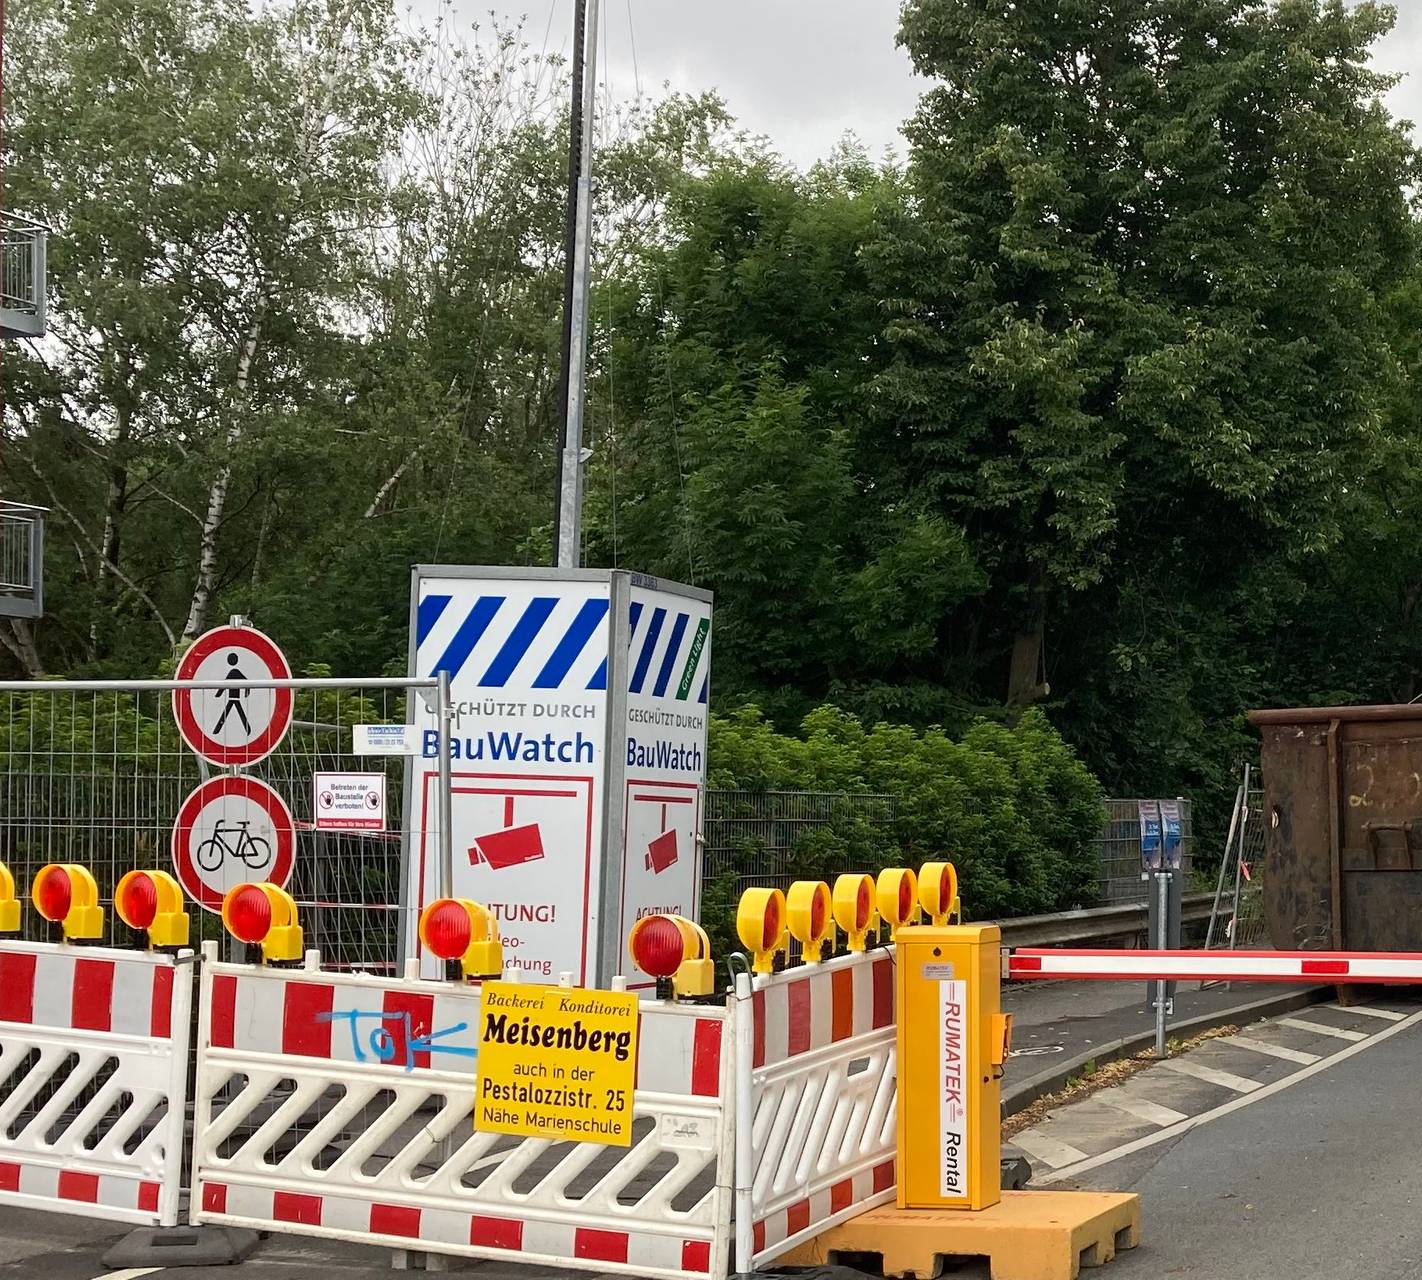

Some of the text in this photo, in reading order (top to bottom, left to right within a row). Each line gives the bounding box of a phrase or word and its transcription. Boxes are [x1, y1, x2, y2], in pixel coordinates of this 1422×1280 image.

[681, 627, 707, 691] Green Light
[425, 699, 596, 719] CHÜTZT DURCH
[628, 707, 703, 730] GESCHÜTZT DURCH
[422, 730, 594, 763] BauWatch
[627, 737, 701, 771] BauWatch
[330, 783, 357, 791] Betreten
[488, 903, 556, 923] TUNG!
[486, 992, 631, 1016] Bäckerei Konditorei
[483, 1013, 631, 1061] Meisenberg
[513, 1062, 595, 1082] auch in der
[483, 1077, 625, 1112] Pestalozzistr. 25
[945, 1001, 962, 1194] RUMATEK Rental
[483, 1106, 622, 1135] Nähe Marienschule
